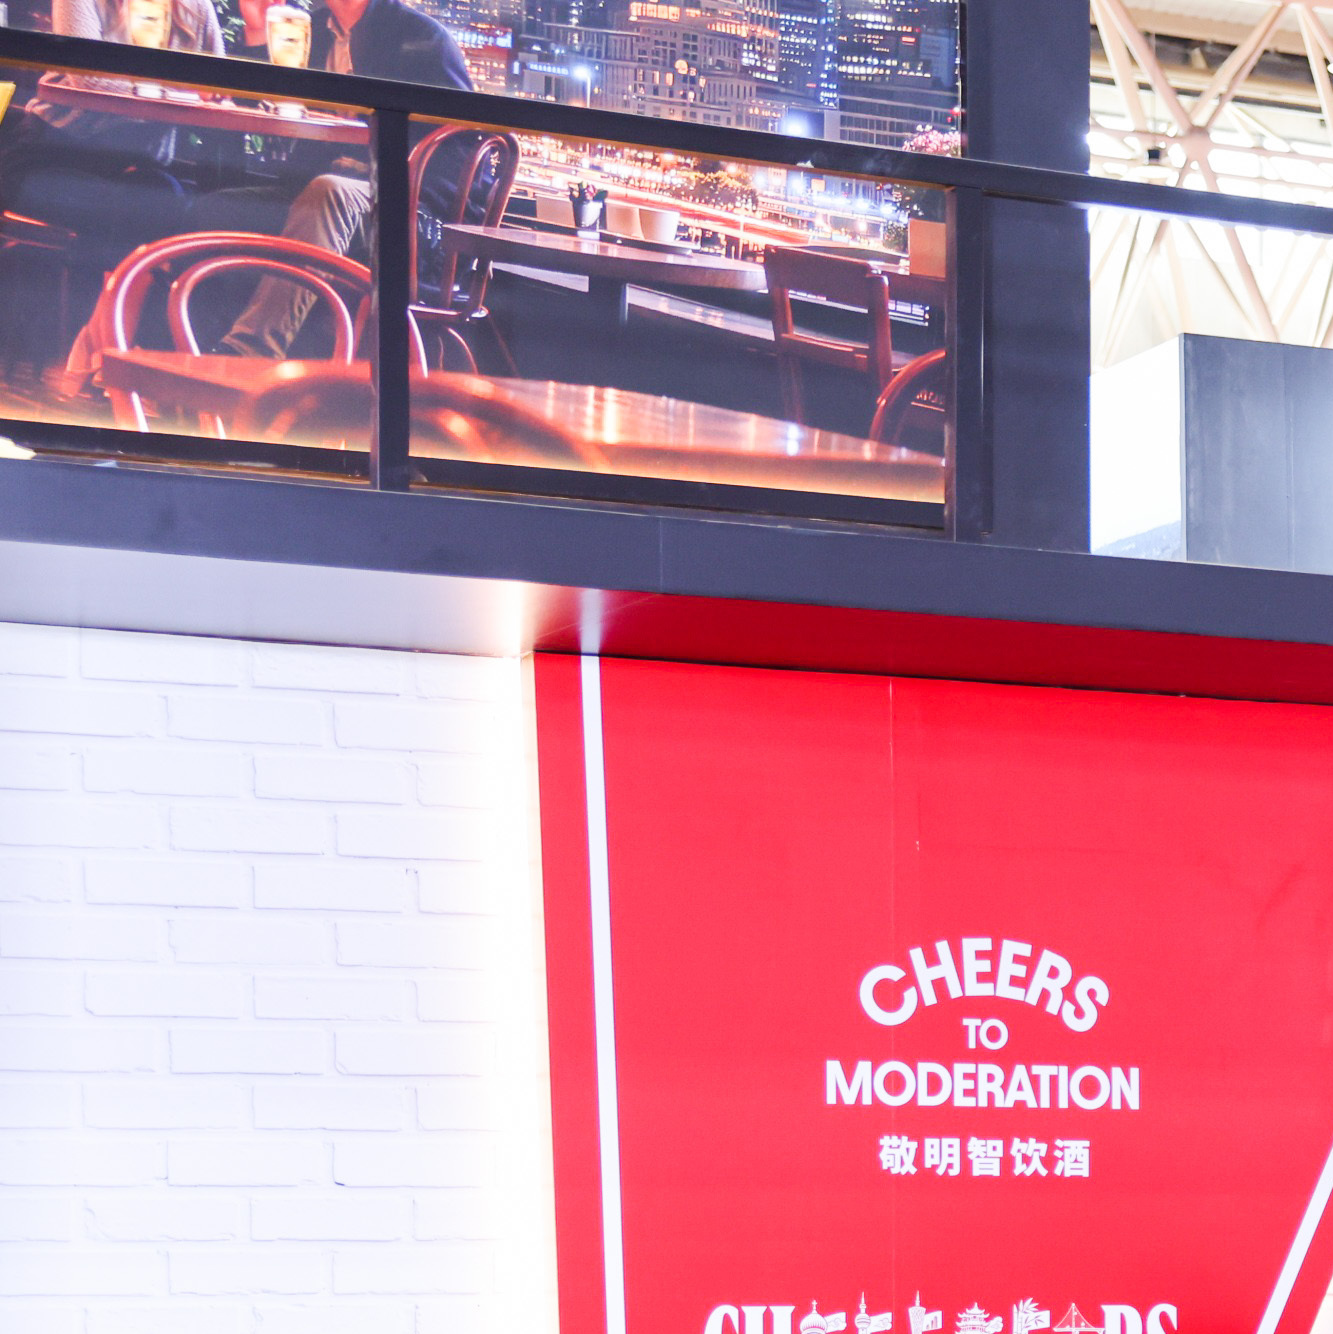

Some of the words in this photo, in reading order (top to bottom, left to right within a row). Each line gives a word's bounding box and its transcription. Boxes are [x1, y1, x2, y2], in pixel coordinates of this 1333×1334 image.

[859, 936, 1110, 1033] CHEERS
[962, 1017, 1009, 1051] TO
[825, 1059, 1141, 1111] MODERATION
[878, 1134, 1091, 1178] 敬明智饮酒
